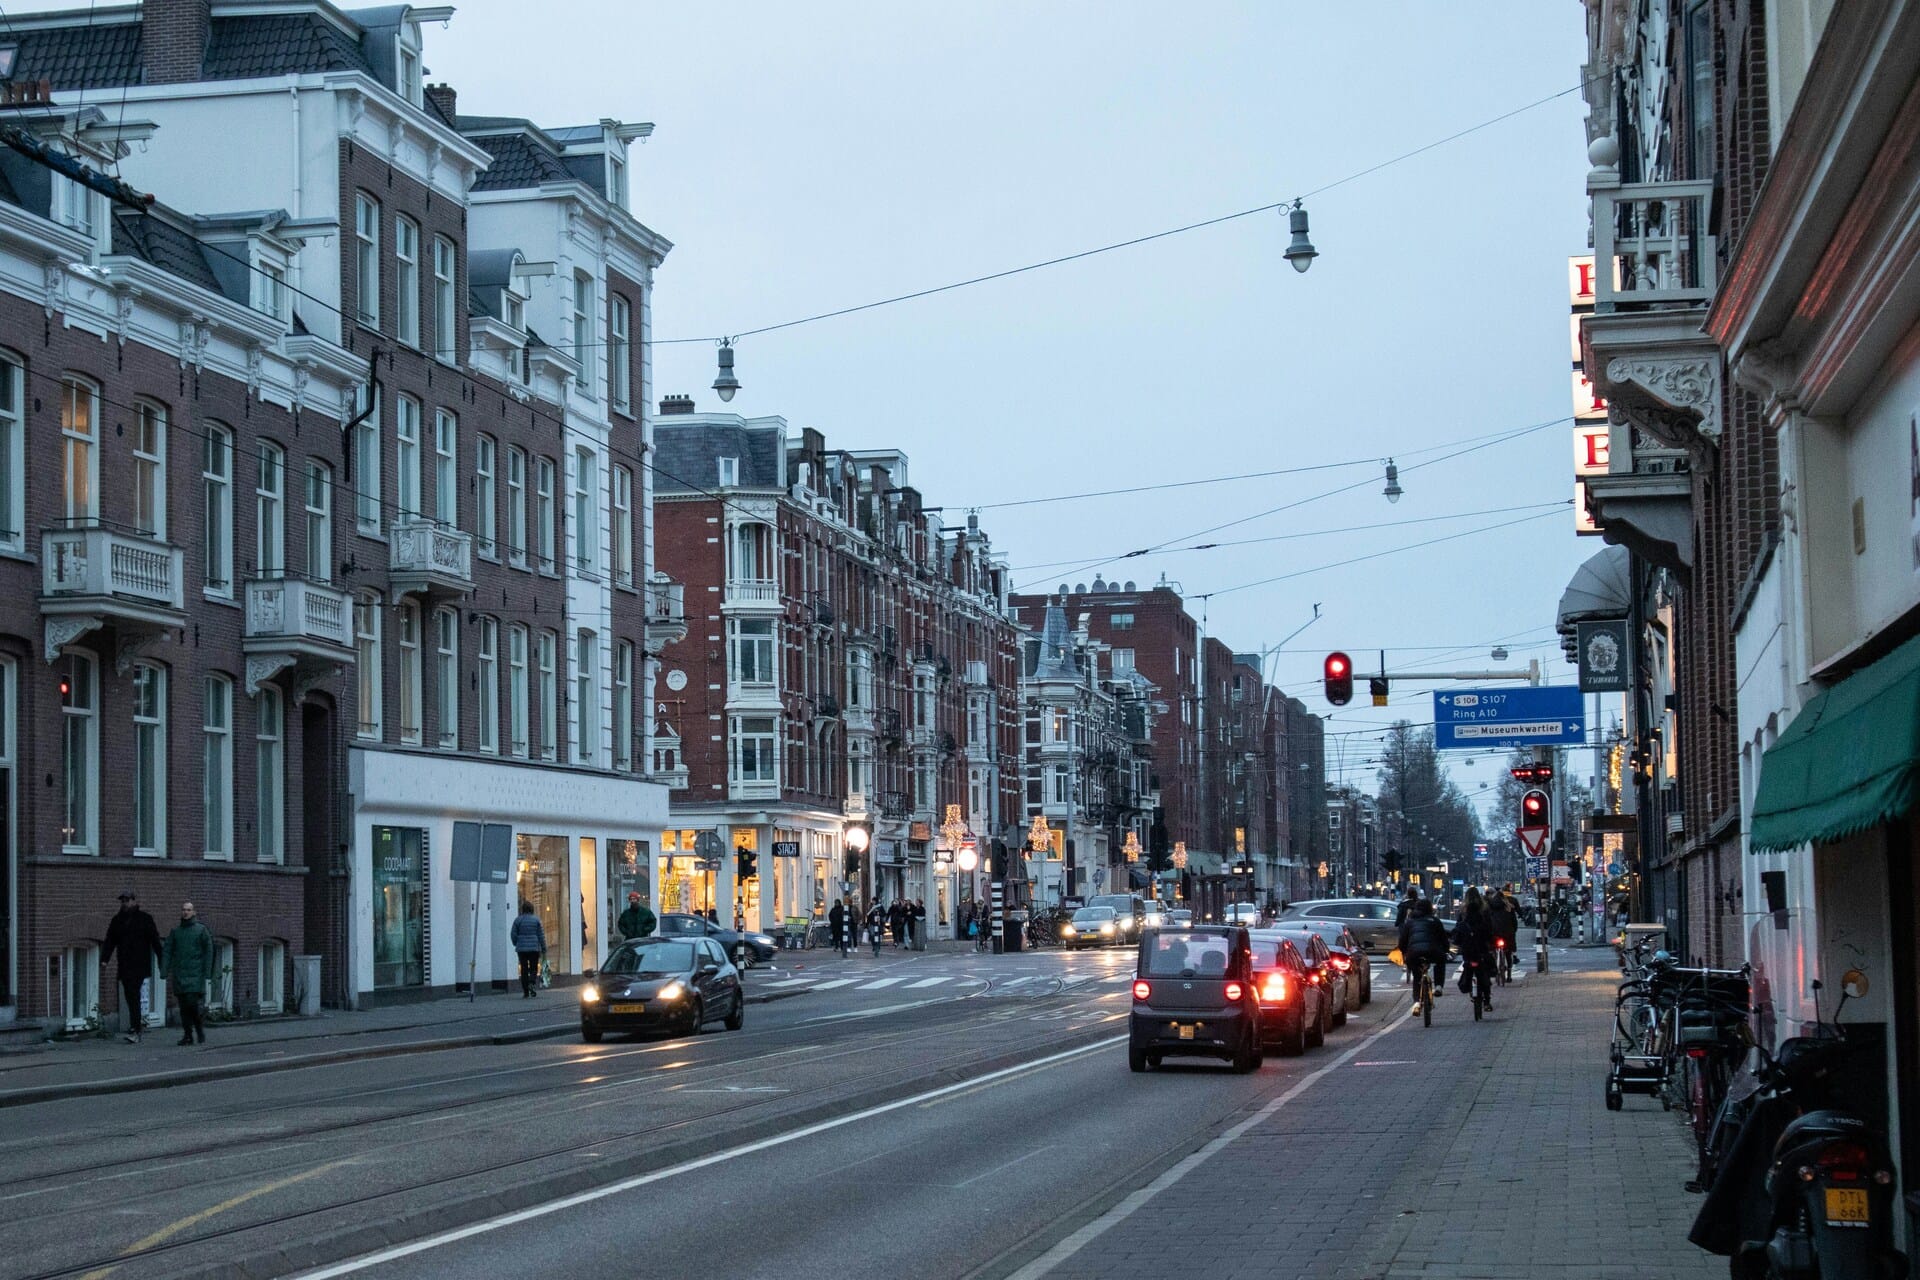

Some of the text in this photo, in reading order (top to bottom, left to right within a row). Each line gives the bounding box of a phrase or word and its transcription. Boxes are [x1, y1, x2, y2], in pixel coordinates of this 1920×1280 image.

[1453, 708, 1497, 720] Ring A10
[1481, 724, 1560, 734] Museumkwartier
[777, 843, 797, 856] STACH
